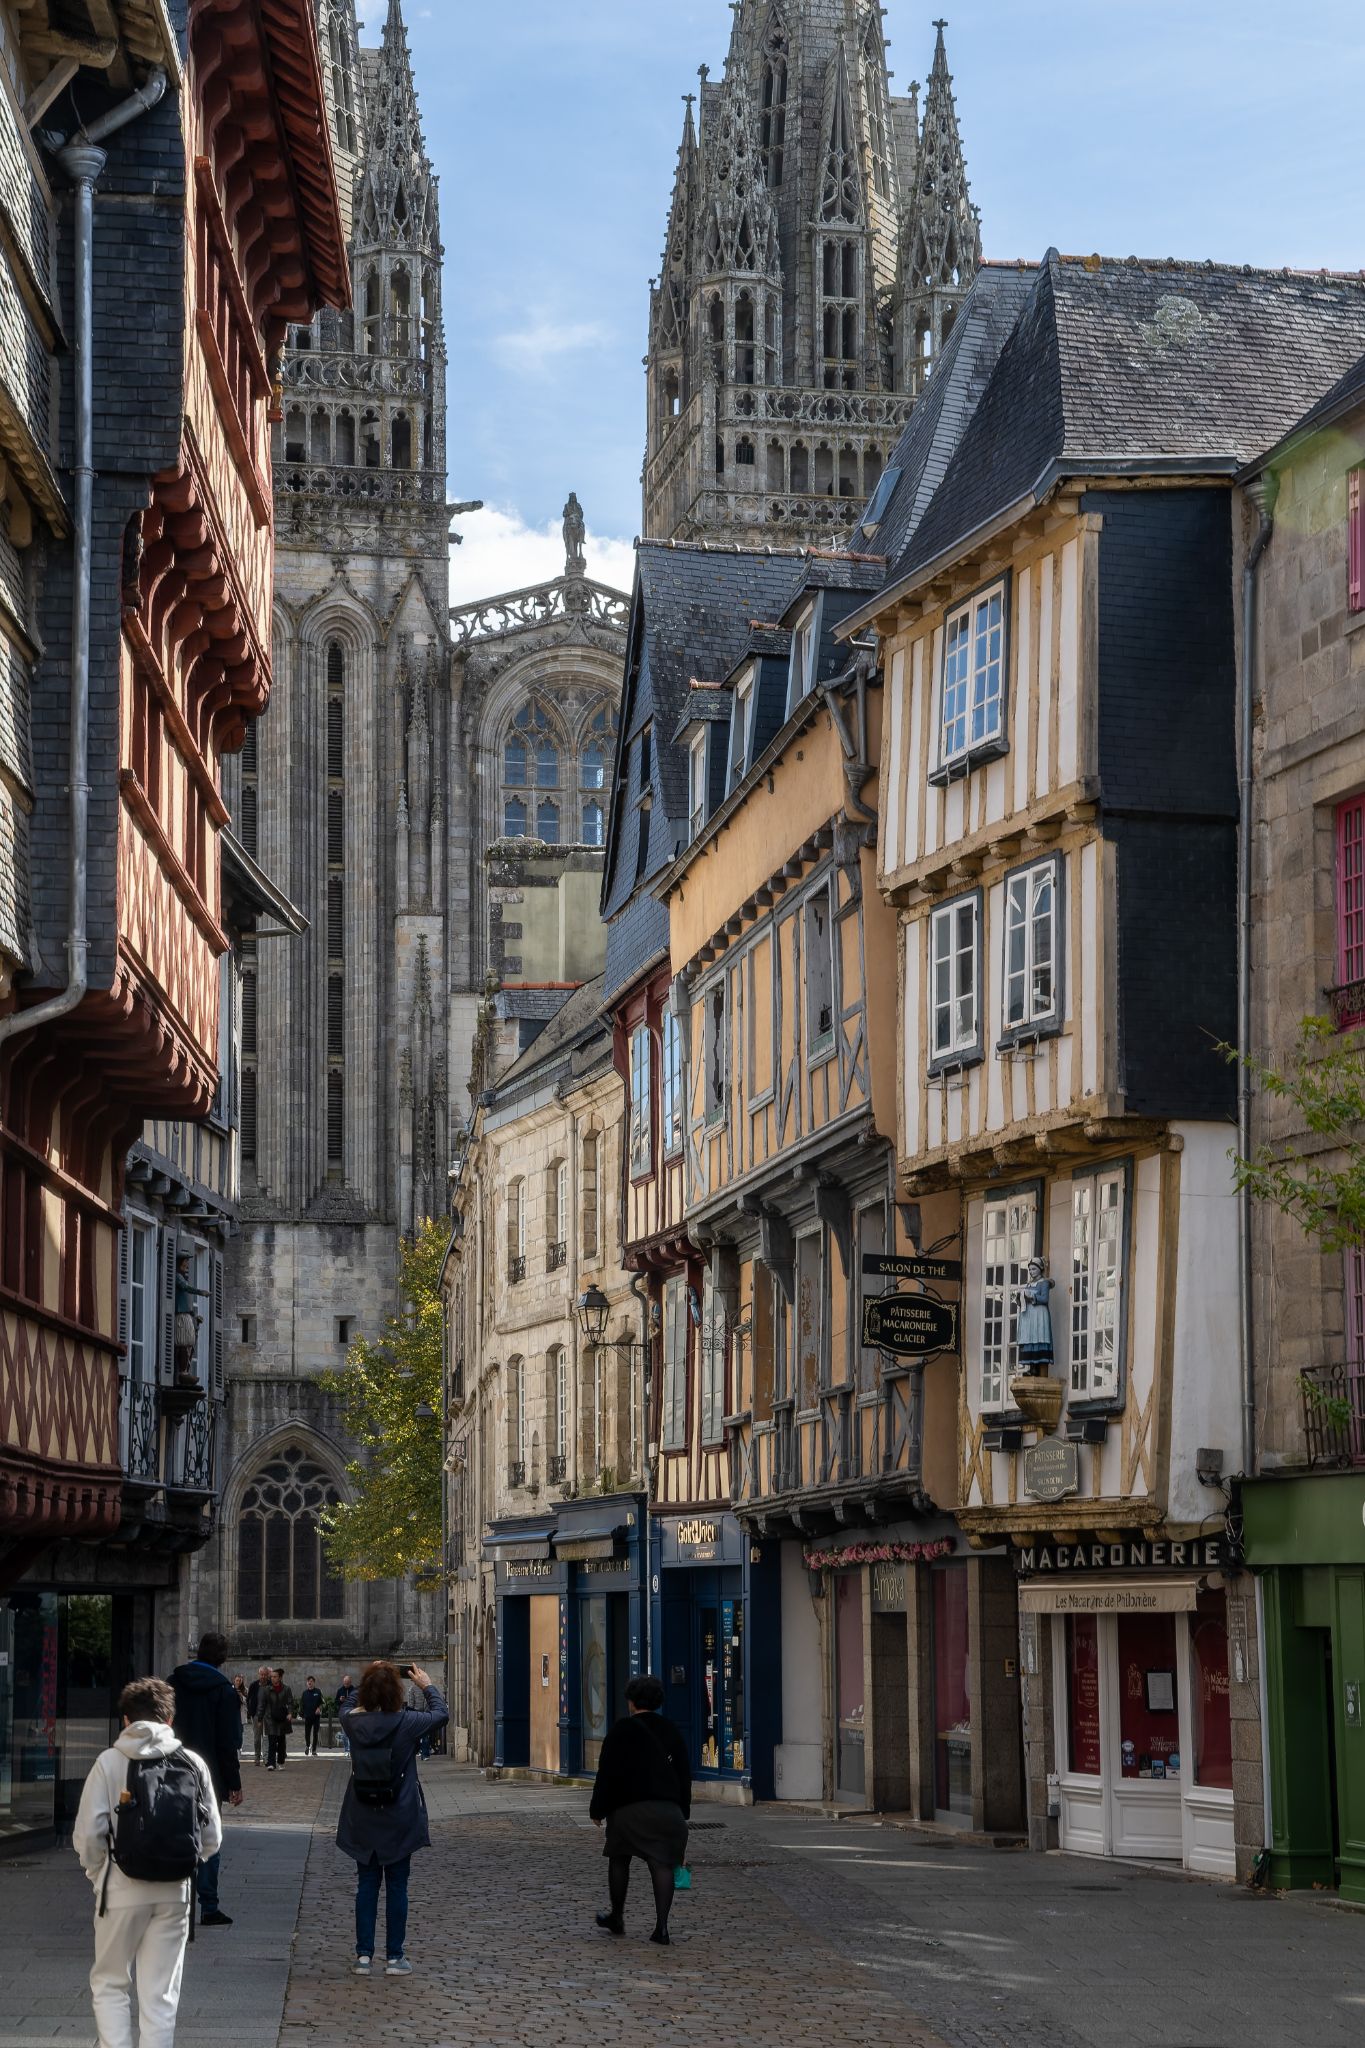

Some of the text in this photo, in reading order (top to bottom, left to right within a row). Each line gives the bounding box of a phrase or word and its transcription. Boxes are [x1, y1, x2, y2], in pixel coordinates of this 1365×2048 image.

[879, 1262, 947, 1276] SALON DE THÉ
[890, 1306, 932, 1319] PÂTISSERIE
[882, 1319, 938, 1332] MACARONERIE
[893, 1333, 926, 1344] GLACIER
[1034, 1448, 1065, 1463] PÂTISSERIE
[1021, 1542, 1220, 1569] MACARONERIE
[1055, 1594, 1067, 1608] Les
[1104, 1593, 1114, 1608] de
[1116, 1592, 1157, 1607] Philomène
